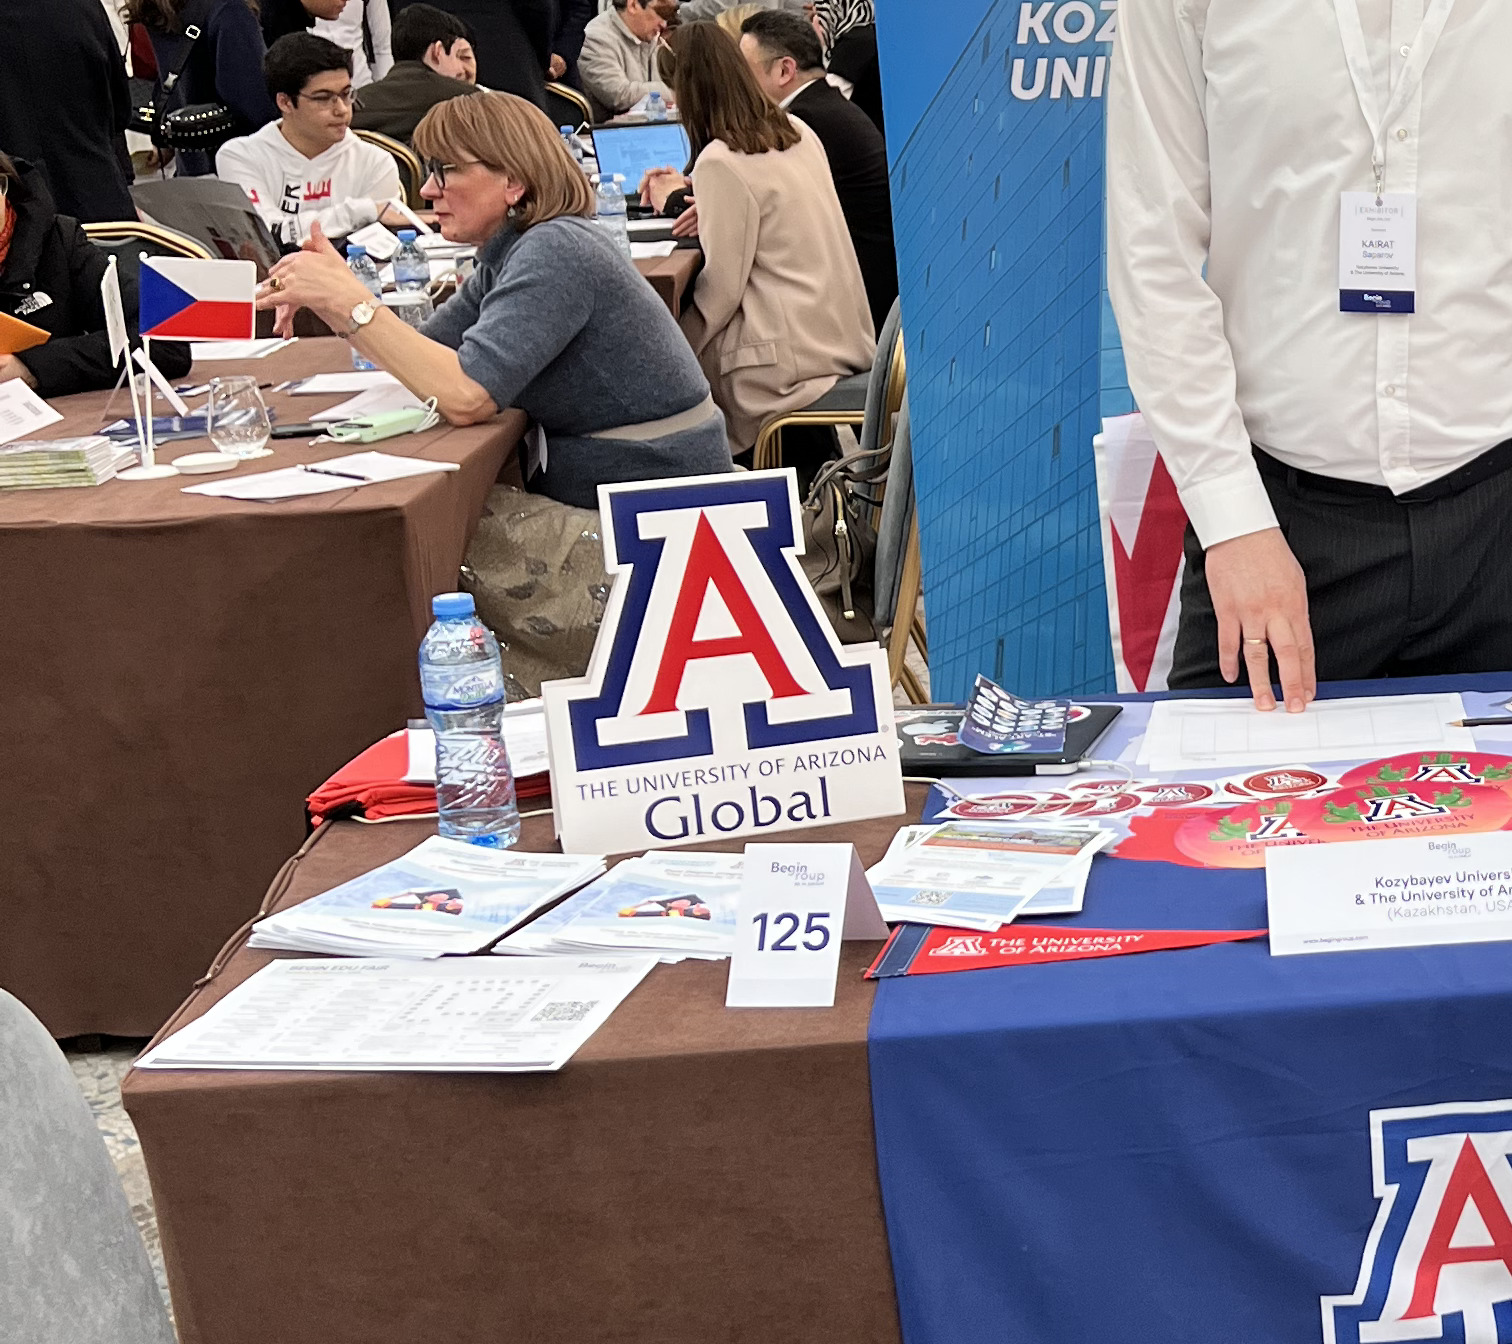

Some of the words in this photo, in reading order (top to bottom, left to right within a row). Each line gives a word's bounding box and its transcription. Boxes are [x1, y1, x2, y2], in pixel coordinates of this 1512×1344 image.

[1016, 0, 1119, 45] KOZ
[1010, 56, 1107, 101] UNI
[281, 184, 300, 214] ER
[576, 780, 619, 801] THE
[626, 762, 750, 794] UNIVERSITY
[759, 758, 785, 777] OF
[793, 744, 886, 773] ARIZONA
[644, 775, 832, 840] Global
[1349, 825, 1377, 834] THE
[1384, 813, 1476, 830] UNIVERSITY
[1365, 829, 1389, 838] OF
[1393, 821, 1469, 836] ARIZONA
[771, 861, 808, 876] Begin
[1375, 872, 1452, 890] Kozybayev
[1354, 893, 1366, 906] &
[1369, 891, 1397, 905] The
[1401, 886, 1476, 903] University
[1479, 884, 1494, 897] of
[1387, 901, 1481, 921] (Kazakhstan,
[752, 912, 831, 952] 125
[990, 937, 1027, 947] THE
[1032, 934, 1145, 946] UNIVERSITY
[999, 946, 1027, 955] OF
[1030, 943, 1123, 954] ARIZONA
